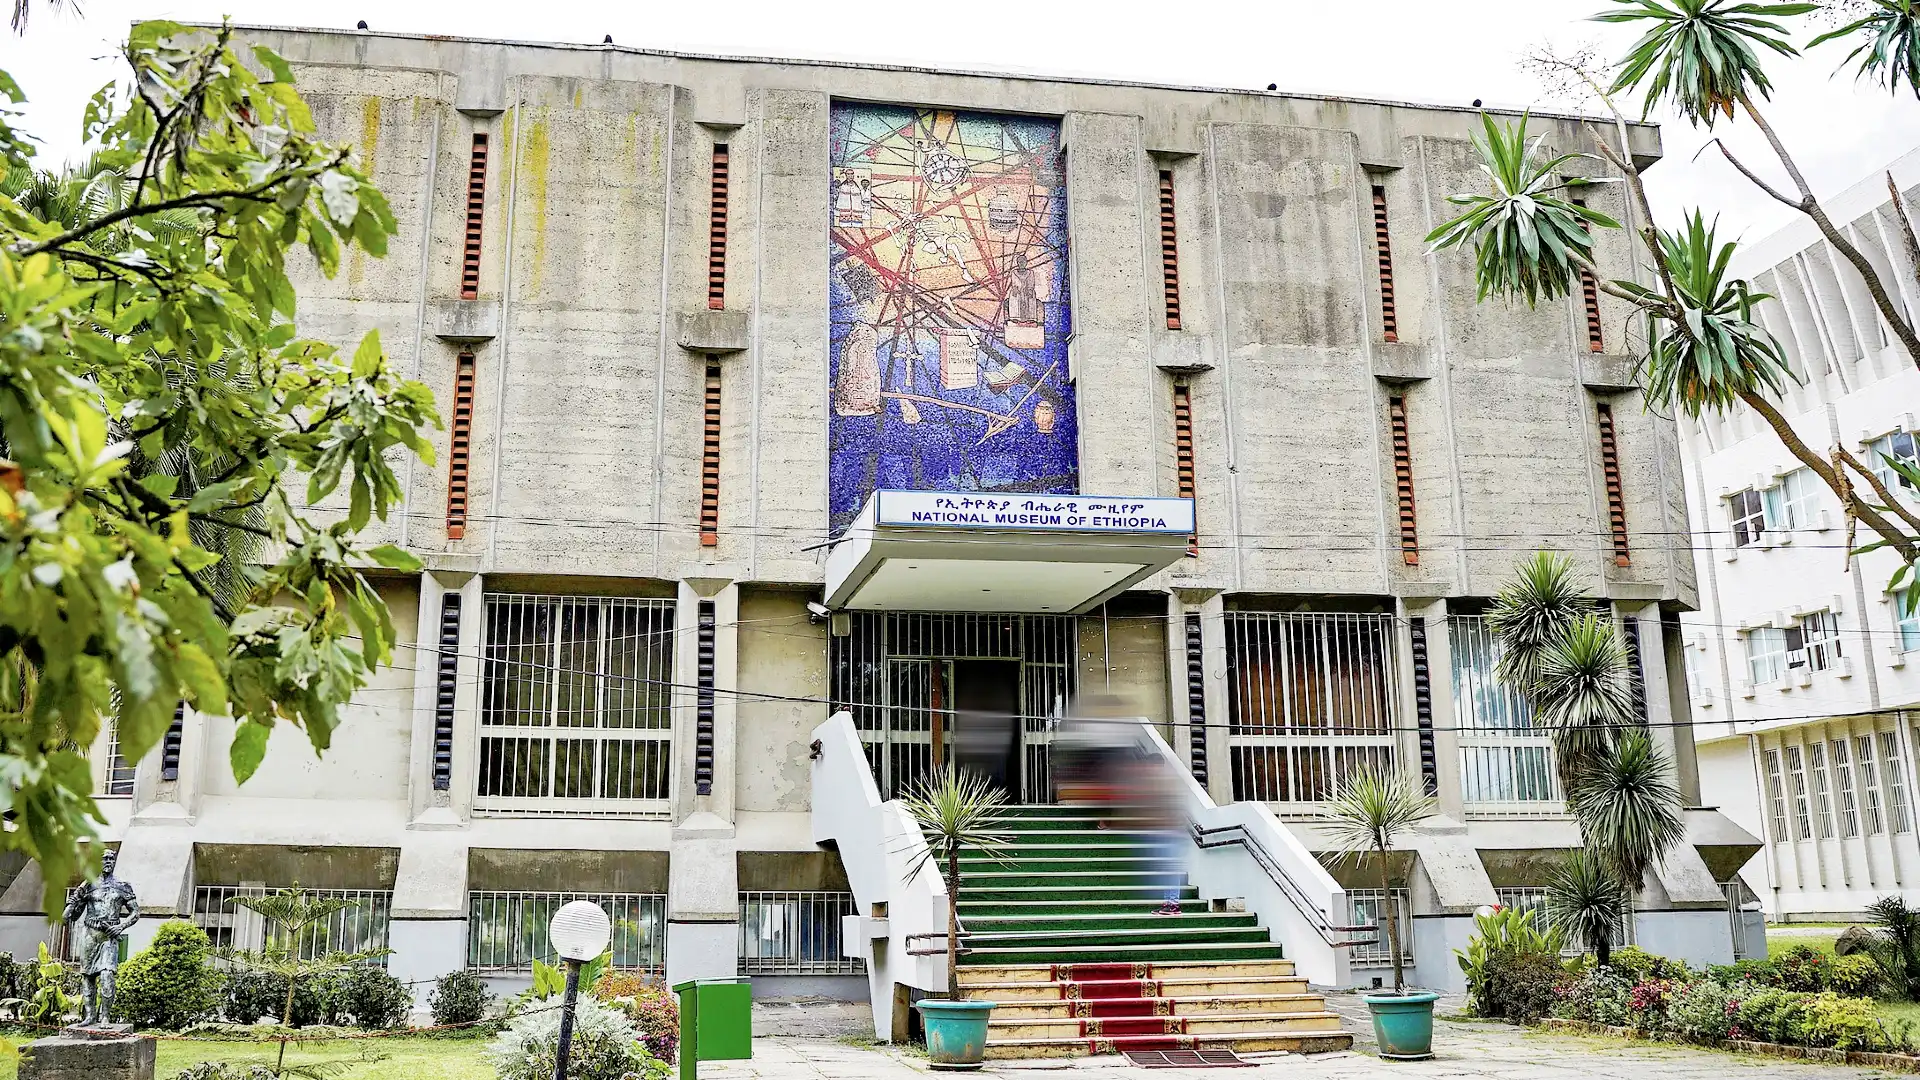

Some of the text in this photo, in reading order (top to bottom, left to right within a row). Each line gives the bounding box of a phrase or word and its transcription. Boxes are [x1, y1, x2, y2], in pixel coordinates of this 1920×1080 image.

[936, 498, 1144, 514] የኢትዮጵያ ብሔራዊ ሙዚየም
[912, 511, 1167, 528] NATIONAL MUSEUM OF ETHIOPIA
